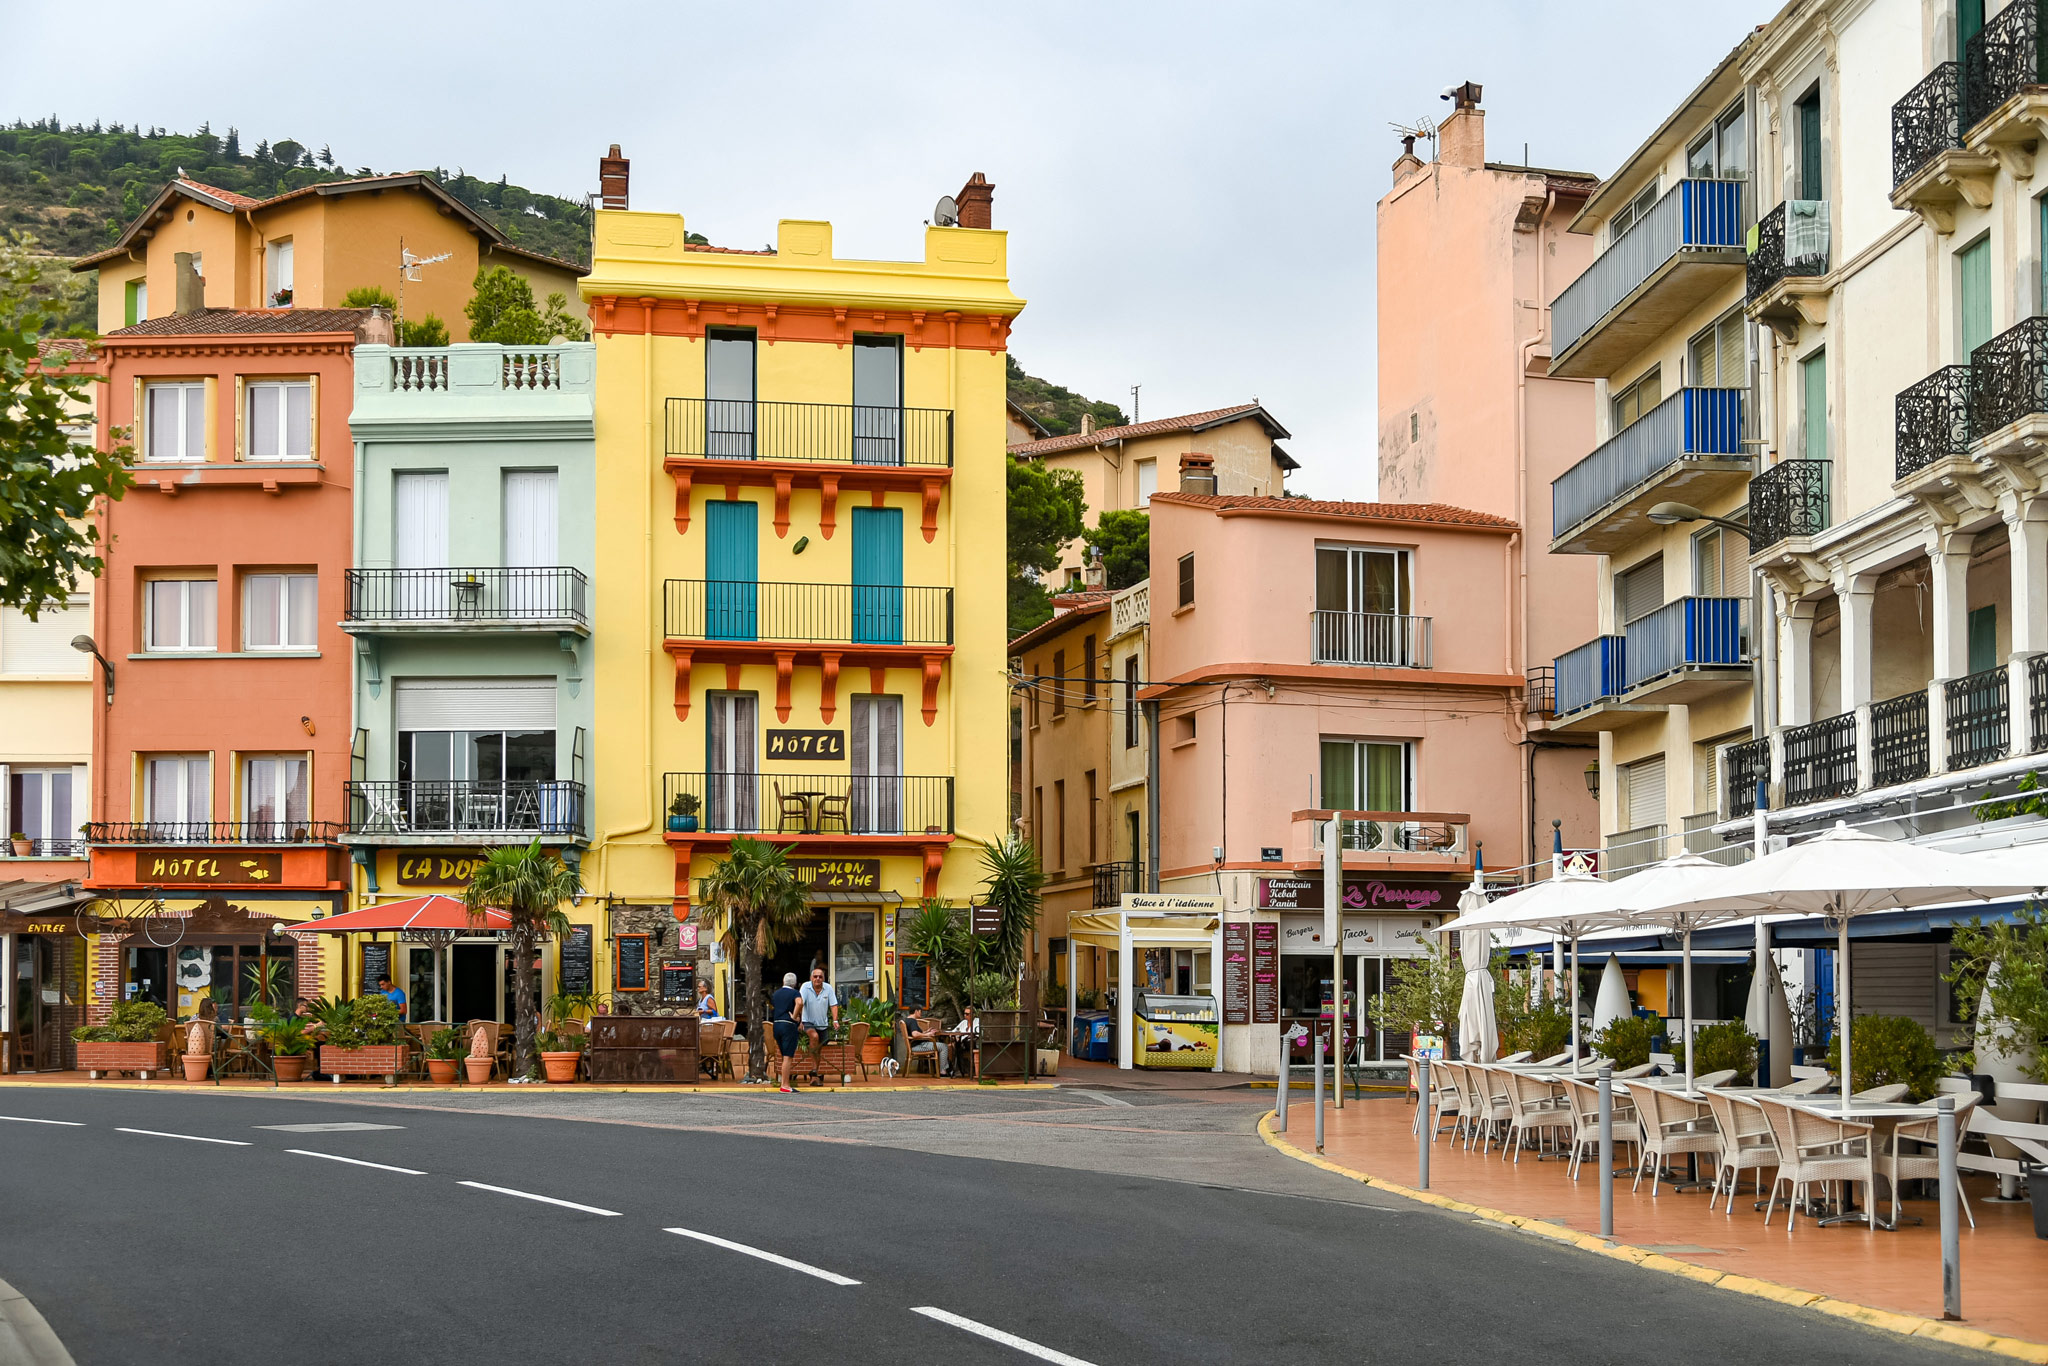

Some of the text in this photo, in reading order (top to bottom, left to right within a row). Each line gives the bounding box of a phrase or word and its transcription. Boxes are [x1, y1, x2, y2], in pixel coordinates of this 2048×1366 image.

[771, 735, 840, 754] HÔTEL
[152, 858, 221, 877] HÔTEL
[402, 857, 433, 879] LA
[817, 862, 865, 875] SALON
[828, 874, 874, 887] de THE
[1268, 878, 1312, 889] Américain
[1268, 888, 1298, 898] Kebab
[1366, 880, 1442, 910] Passage
[1131, 897, 1157, 908] Glace
[1159, 898, 1165, 907] à
[1268, 898, 1298, 908] Panini
[27, 923, 66, 933] ENTREE
[1286, 926, 1314, 938] Burgers
[1343, 929, 1369, 940] Tacos
